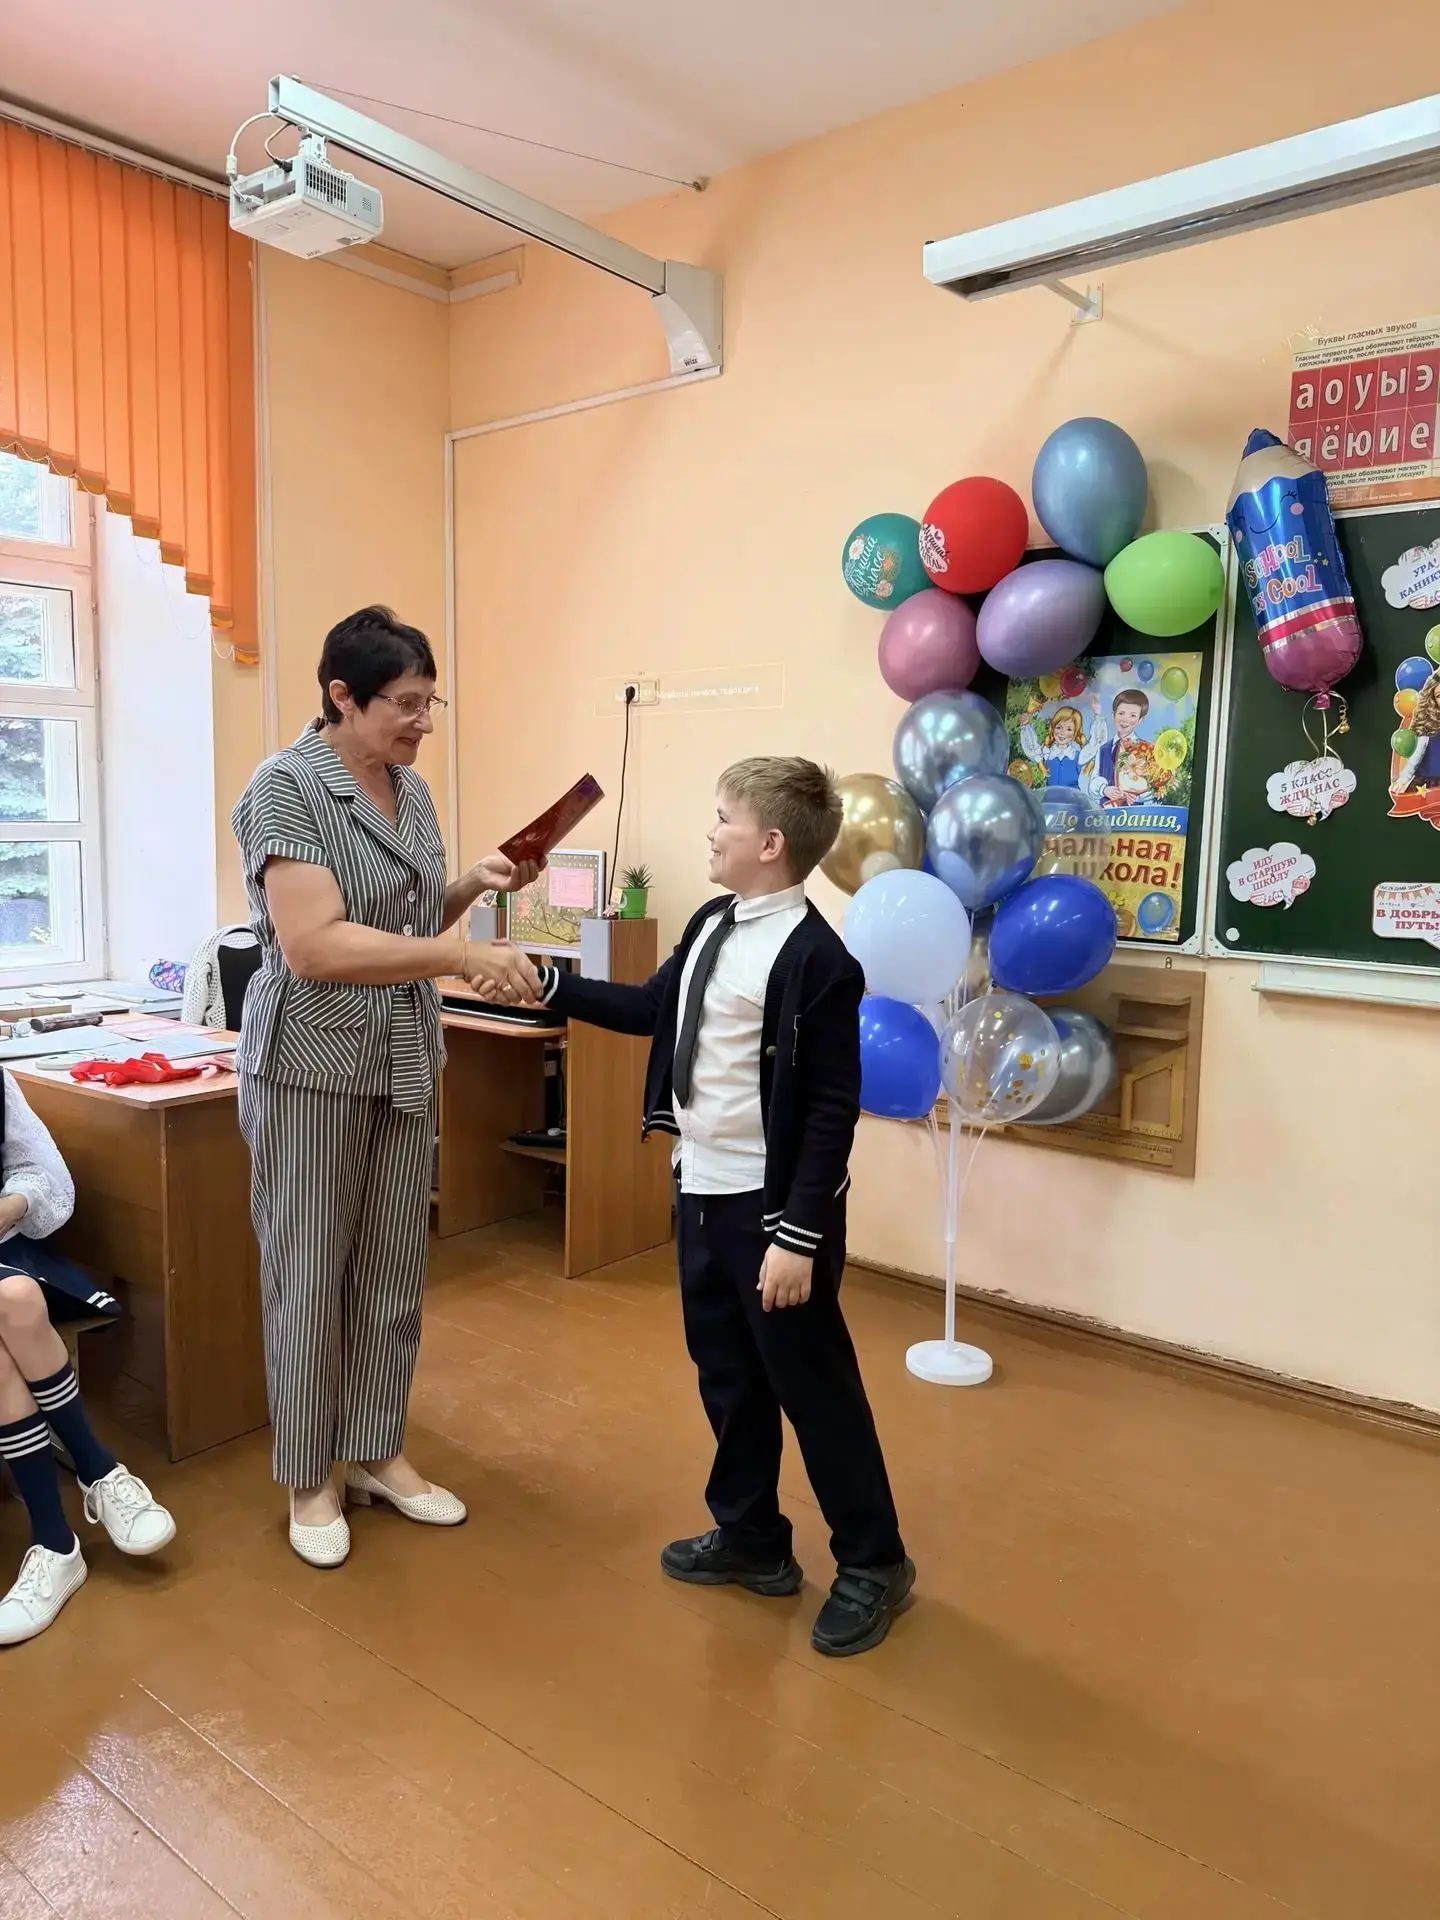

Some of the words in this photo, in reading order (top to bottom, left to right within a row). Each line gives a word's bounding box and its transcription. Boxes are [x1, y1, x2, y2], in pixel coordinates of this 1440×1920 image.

[1317, 334, 1346, 346] Буквы
[1348, 327, 1383, 341] гласных
[1386, 321, 1418, 333] звуков
[1281, 783, 1287, 793] 5
[1291, 768, 1333, 789] КЛАСС
[1280, 788, 1309, 805] ЖДИ
[1314, 778, 1340, 795] НАС
[1084, 810, 1182, 831] свидания,
[1238, 878, 1245, 887] В
[1246, 856, 1298, 883] СТАРШУЮ
[1253, 854, 1273, 870] ИДУ
[1253, 870, 1290, 891] ШКОЛУ
[1376, 909, 1386, 918] В
[1395, 920, 1440, 931] ПУТЬ!
